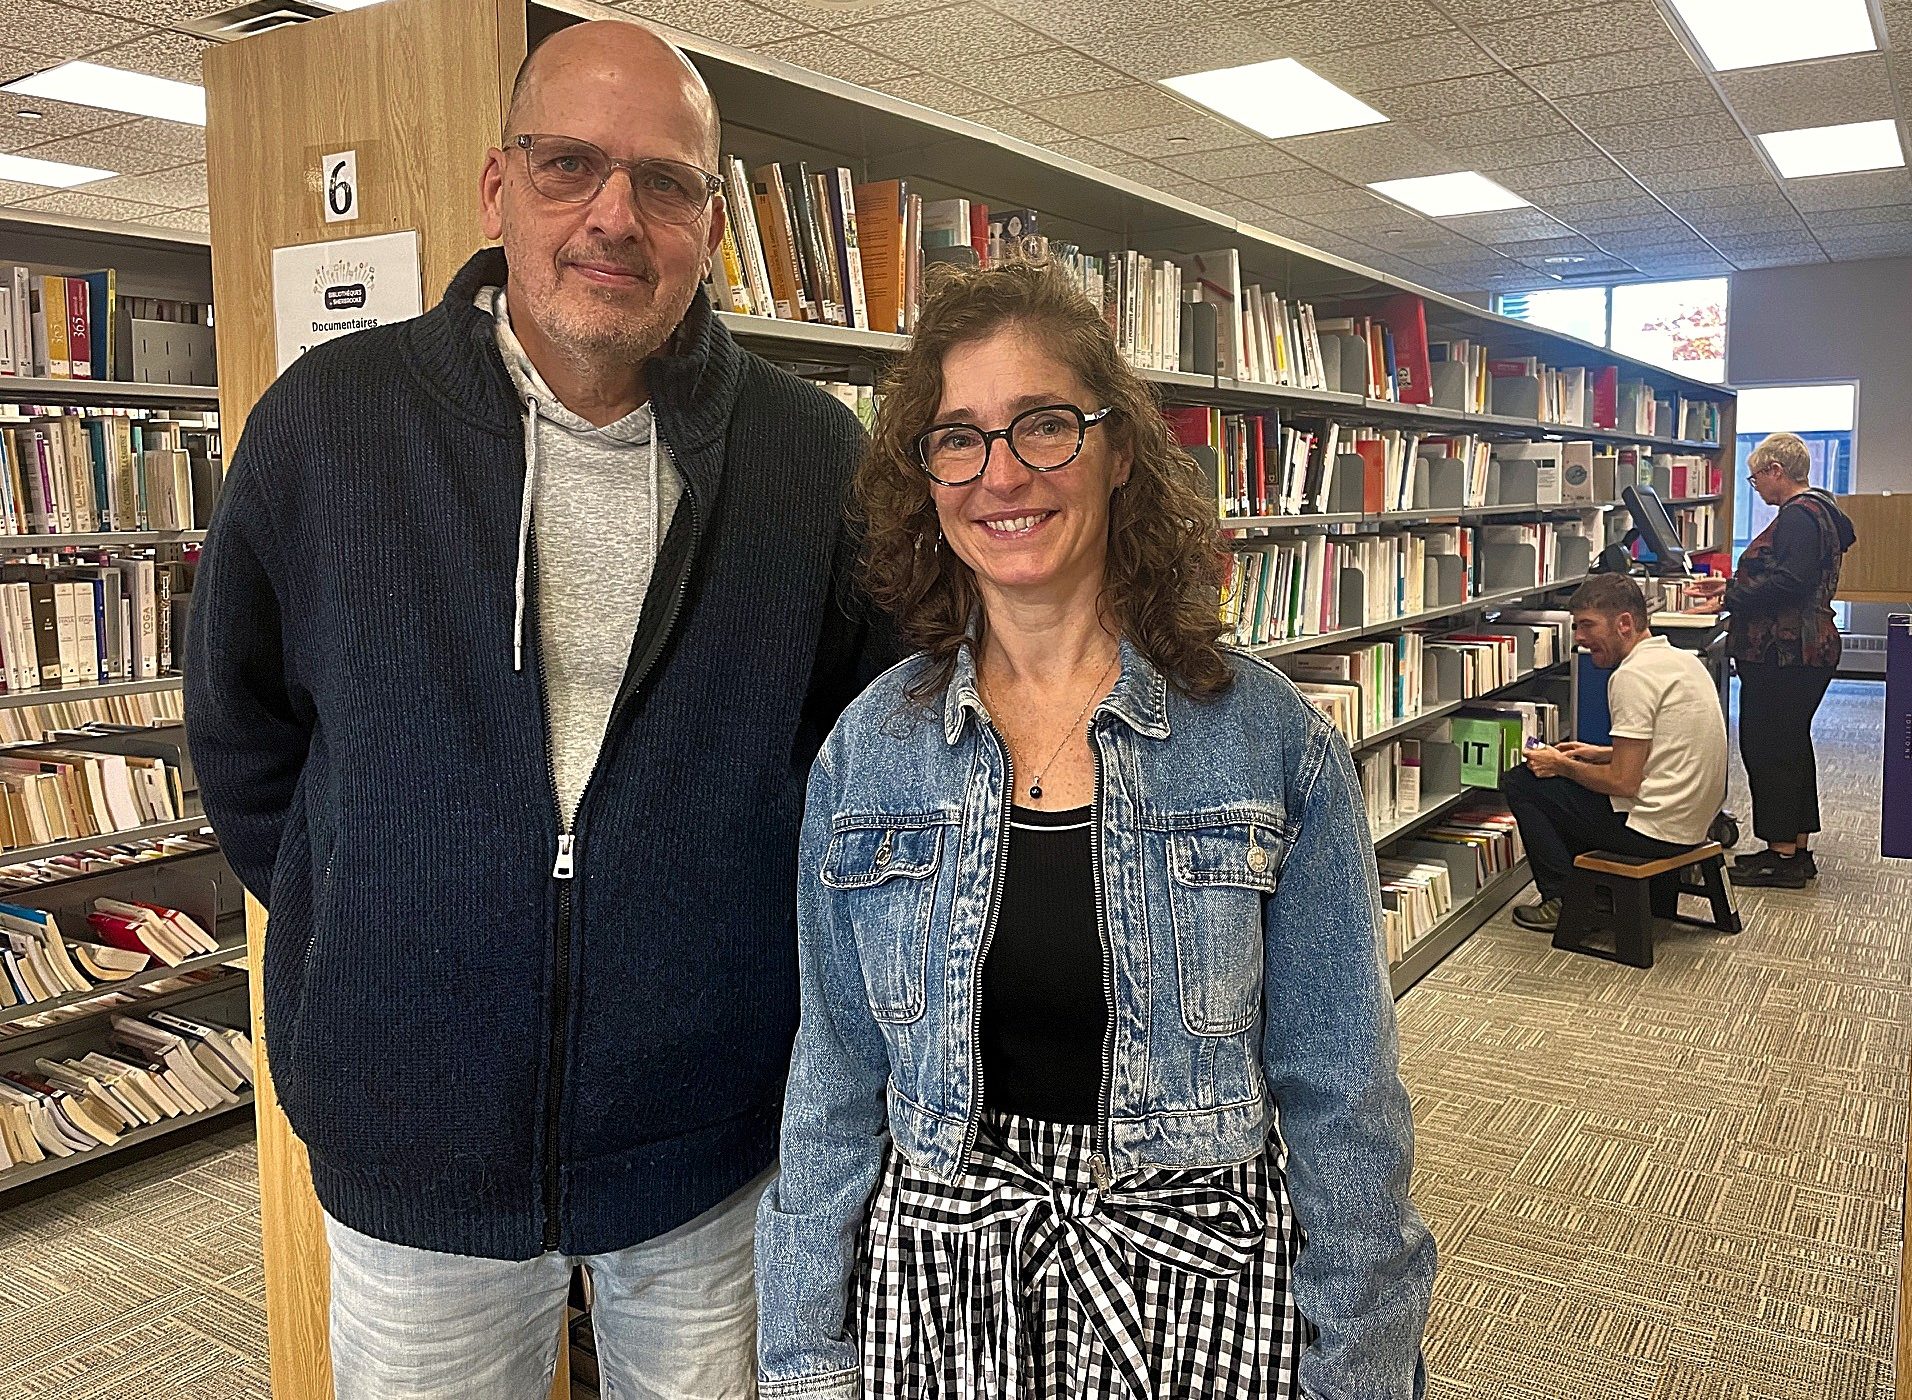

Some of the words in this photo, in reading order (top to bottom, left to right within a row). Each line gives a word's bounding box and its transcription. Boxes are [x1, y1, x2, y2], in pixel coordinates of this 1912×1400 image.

[329, 161, 352, 215] 6
[73, 316, 86, 339] 365
[311, 317, 378, 333] Documentaires
[118, 434, 126, 459] SAGESSE
[142, 606, 151, 636] YOGA
[1463, 741, 1489, 766] IT
